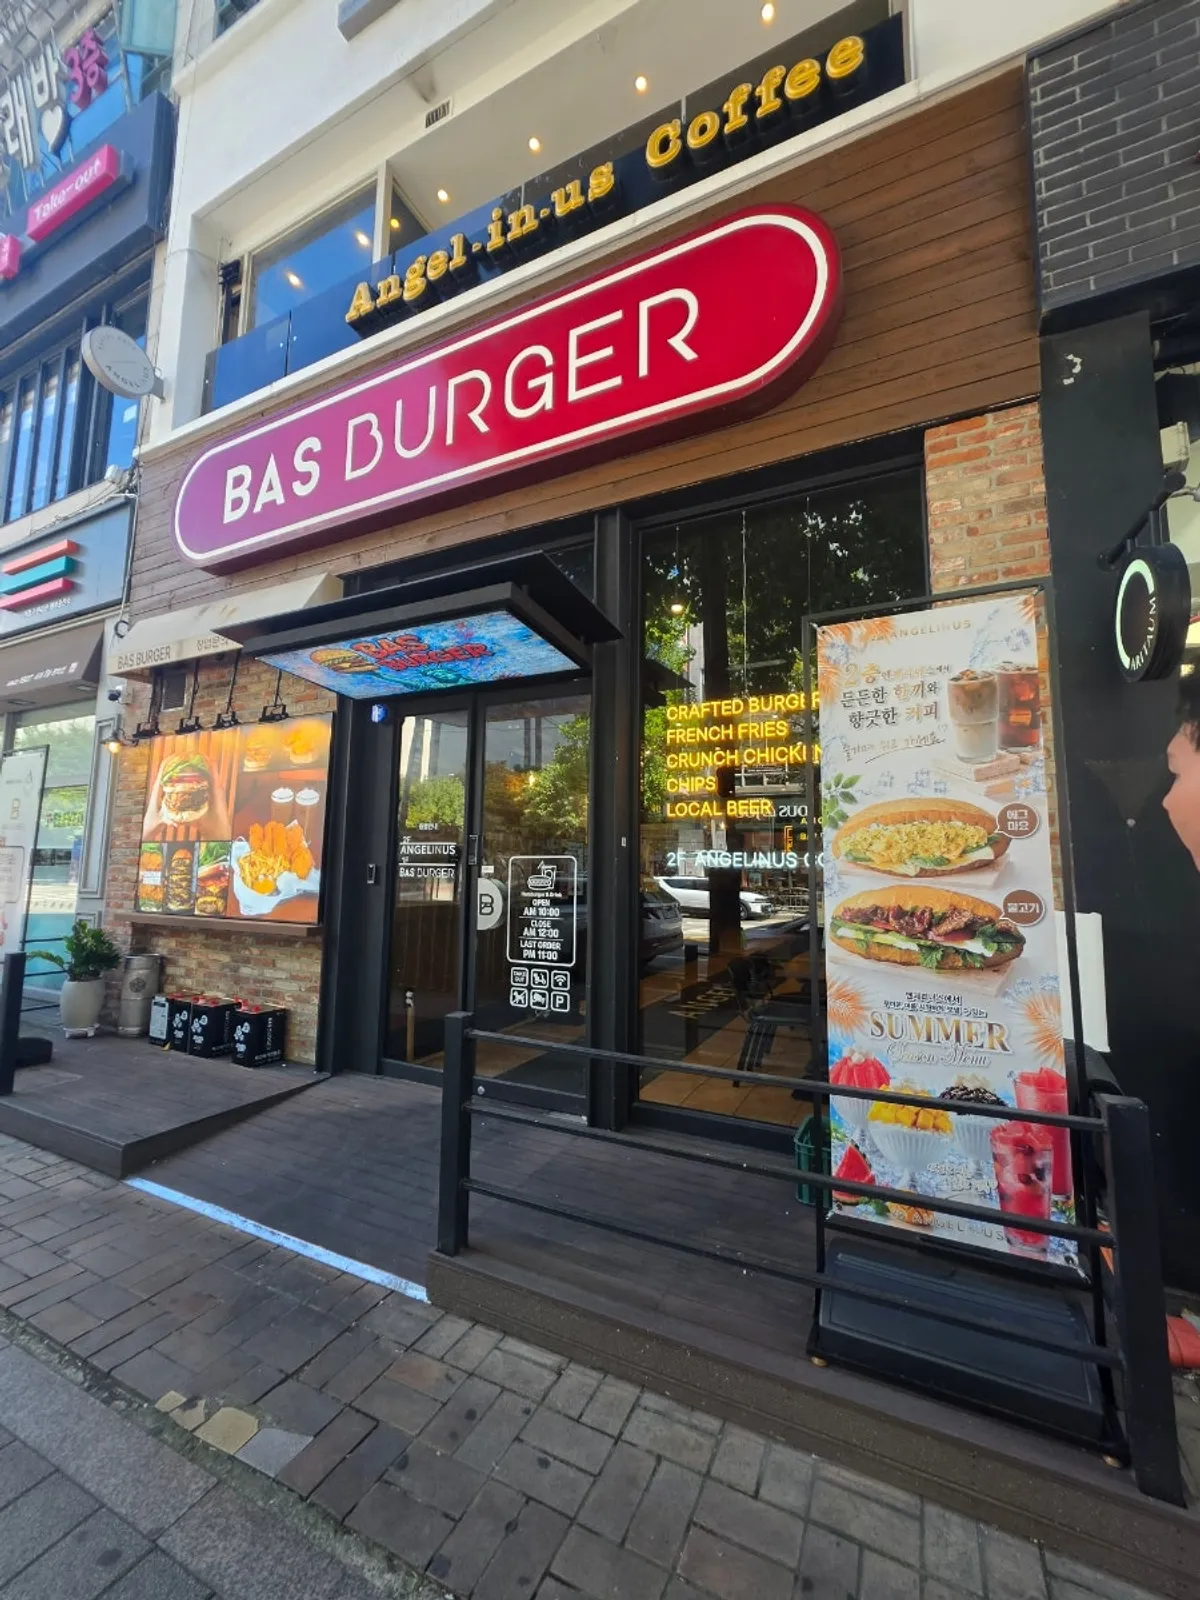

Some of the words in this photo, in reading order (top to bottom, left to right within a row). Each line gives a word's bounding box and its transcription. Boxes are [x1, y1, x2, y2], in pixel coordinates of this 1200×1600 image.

[645, 35, 865, 170] Coffee
[222, 438, 322, 525] BAS
[344, 287, 701, 482] BURGER
[117, 654, 135, 670] BAS
[136, 645, 172, 666] BURGER
[841, 686, 888, 708] 든든한
[667, 699, 743, 721] CRAFTED
[849, 706, 898, 729] 향긋한
[905, 701, 938, 721] 커피
[667, 724, 733, 744] FRENCH
[738, 720, 788, 739] FRIES
[667, 749, 739, 769] CRUNCH
[667, 776, 716, 793] CHIPS
[667, 801, 722, 817] LOCAL
[727, 799, 773, 816] BEER
[400, 845, 456, 855] ANGELINUS
[667, 852, 686, 867] 2F
[695, 852, 798, 869] ANGELINUS
[400, 867, 415, 877] BAS
[417, 867, 455, 878] BURGER
[523, 907, 536, 916] AM
[538, 907, 560, 917] 10:00
[523, 927, 536, 936] AM
[538, 928, 559, 938] 12:00
[530, 920, 551, 928] CLOSE
[520, 940, 536, 948] LAST
[537, 941, 561, 950] ORDER
[523, 949, 536, 958] PM
[538, 950, 558, 960] 11:00
[555, 995, 565, 1008] P
[870, 1010, 1010, 1052] SUMMER
